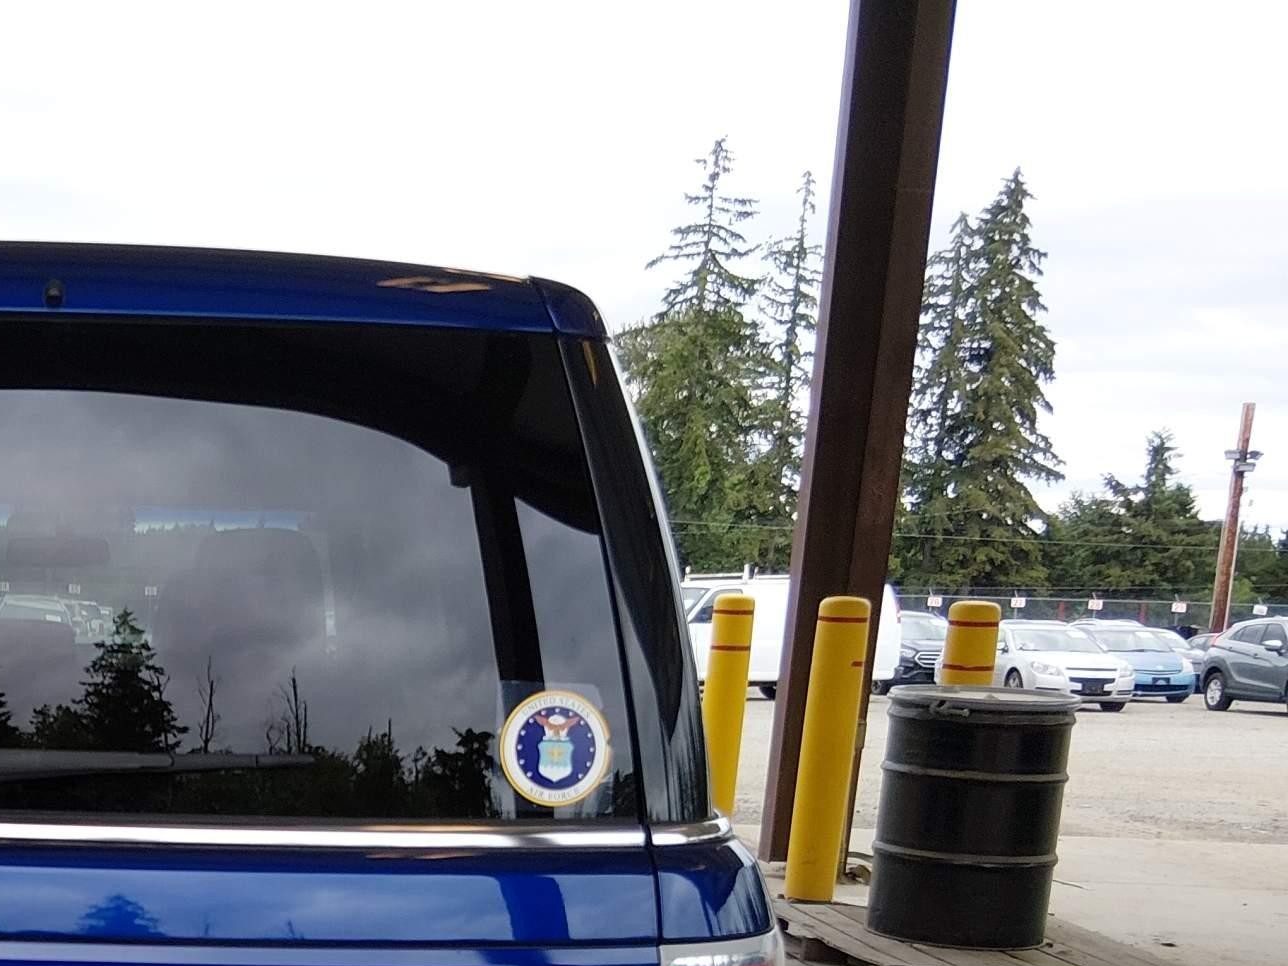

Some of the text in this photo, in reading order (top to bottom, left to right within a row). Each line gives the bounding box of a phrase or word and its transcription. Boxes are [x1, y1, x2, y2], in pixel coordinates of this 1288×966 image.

[522, 696, 591, 718] UNITED STATES
[528, 786, 580, 801] AIR FORCE
